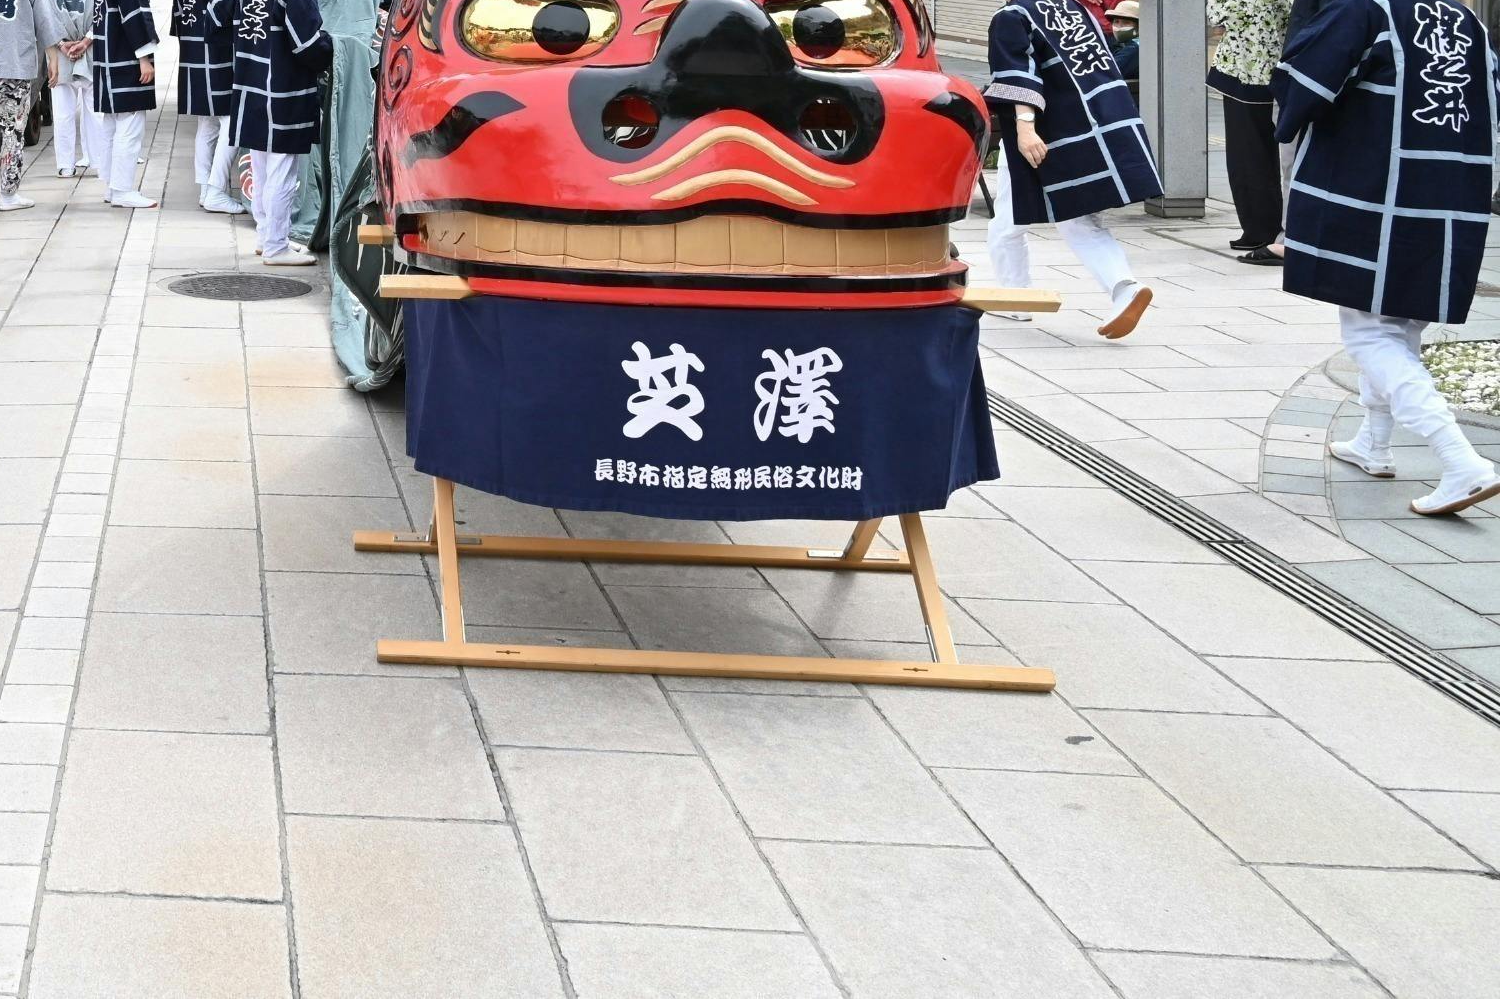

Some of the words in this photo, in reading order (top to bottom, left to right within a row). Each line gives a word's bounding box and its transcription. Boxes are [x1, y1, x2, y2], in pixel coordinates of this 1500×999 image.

[594, 458, 863, 491] 長野市指定無形民俗文化財
